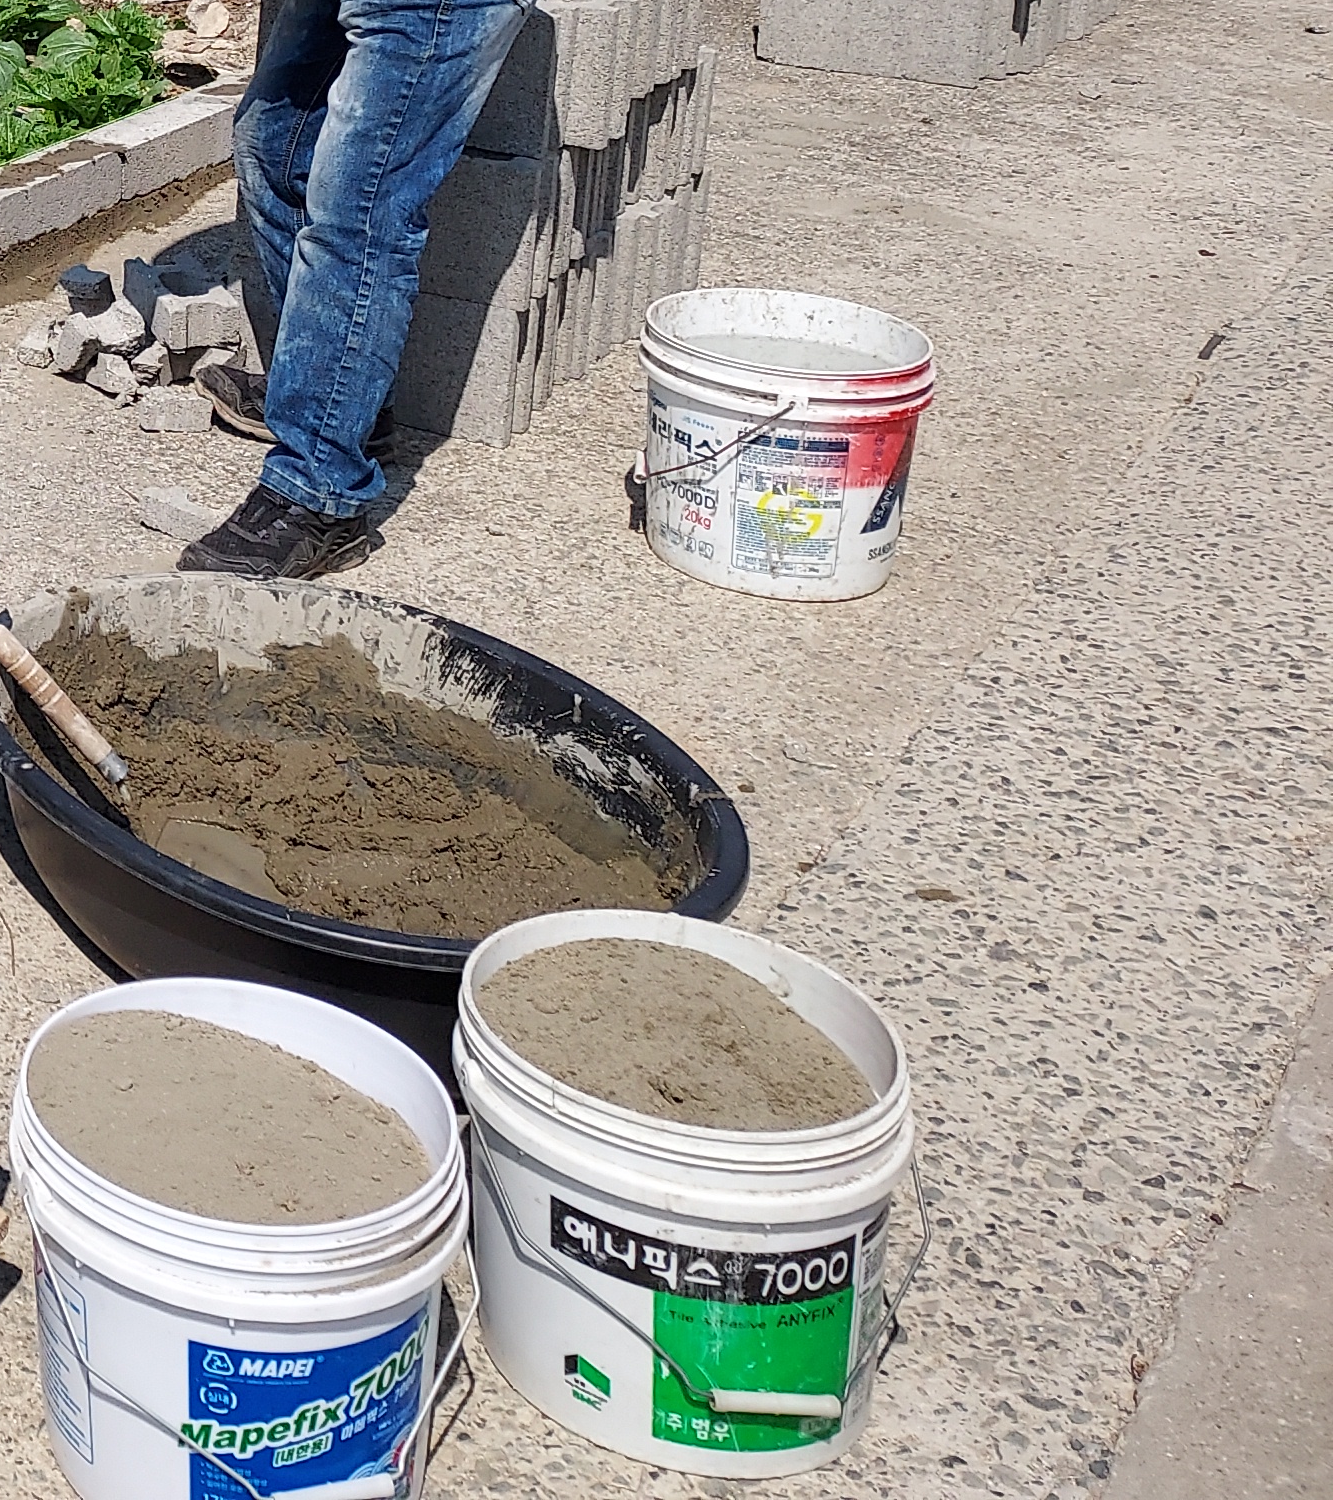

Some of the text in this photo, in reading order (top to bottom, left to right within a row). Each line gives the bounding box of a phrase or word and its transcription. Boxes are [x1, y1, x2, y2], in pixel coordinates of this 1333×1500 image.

[684, 507, 712, 531] 20kg
[562, 1214, 849, 1298] 애니픽스 7000
[178, 1402, 344, 1454] Mapefix
[352, 1316, 430, 1413] 7000
[238, 1357, 316, 1379] MAPEI
